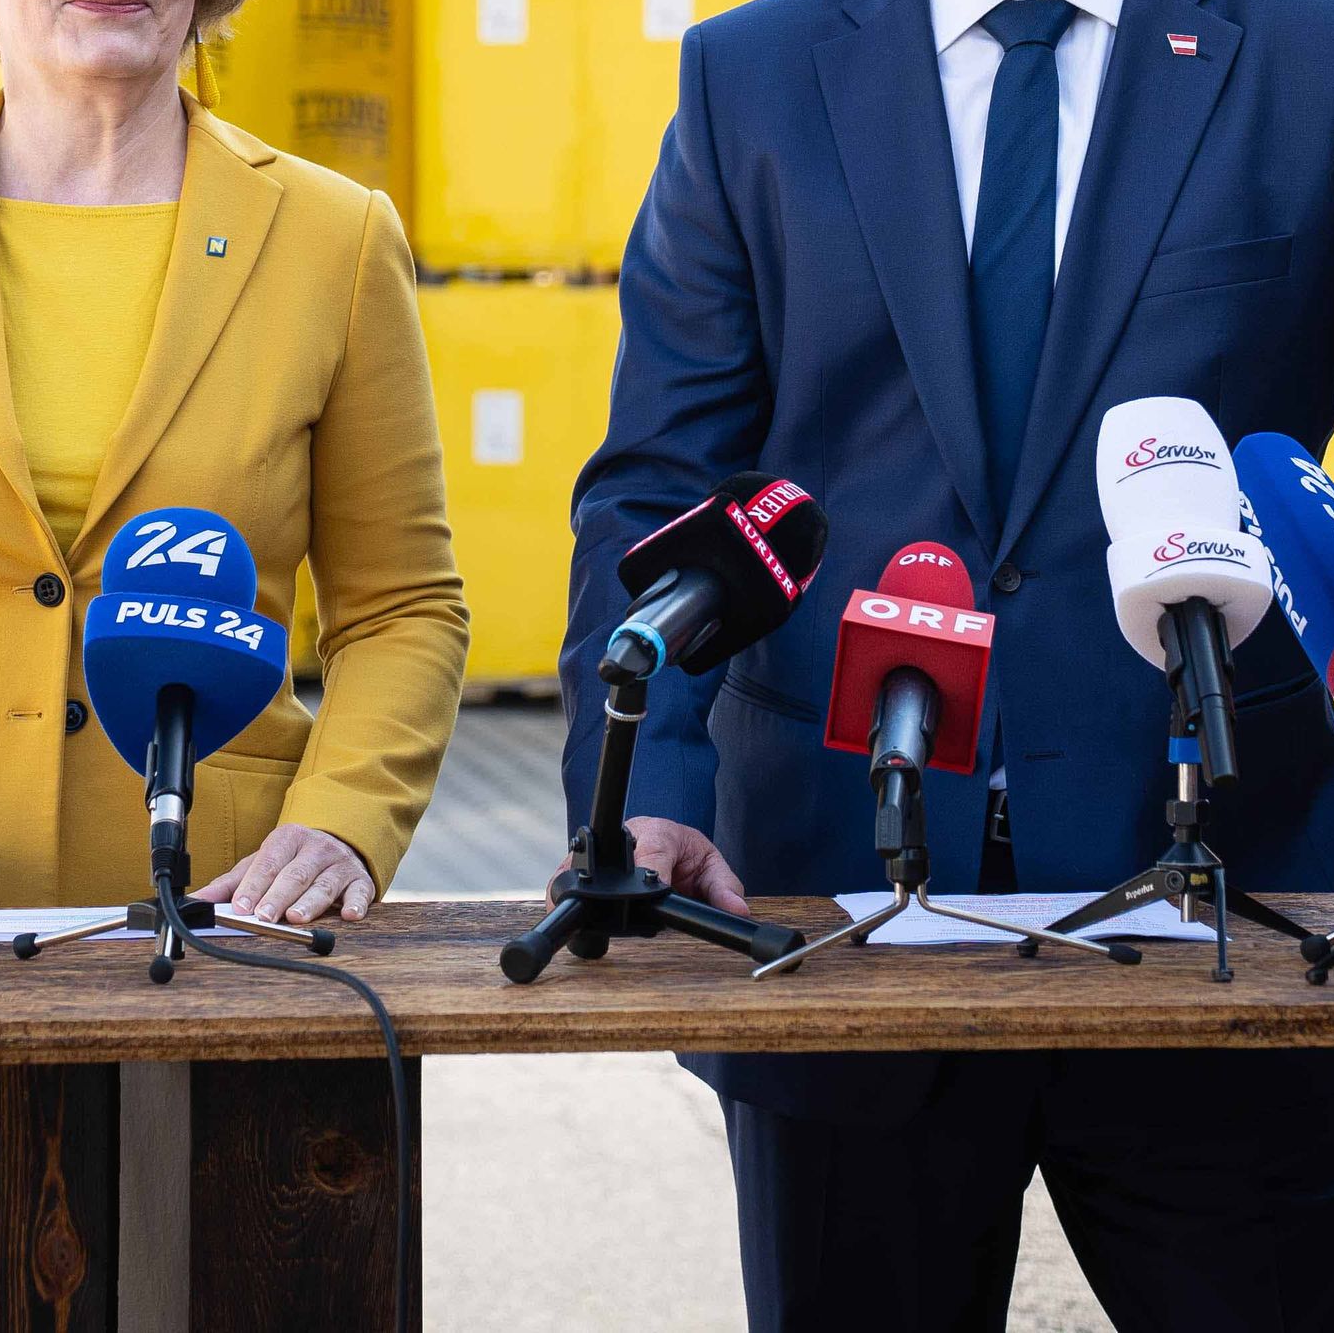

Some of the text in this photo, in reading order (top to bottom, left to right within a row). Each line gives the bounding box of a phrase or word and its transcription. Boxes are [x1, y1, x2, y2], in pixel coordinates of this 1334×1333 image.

[126, 521, 227, 577] 24
[731, 507, 794, 595] KURIER
[899, 552, 954, 567] ORF
[116, 601, 264, 651] PULS 24
[860, 598, 988, 634] ORF
